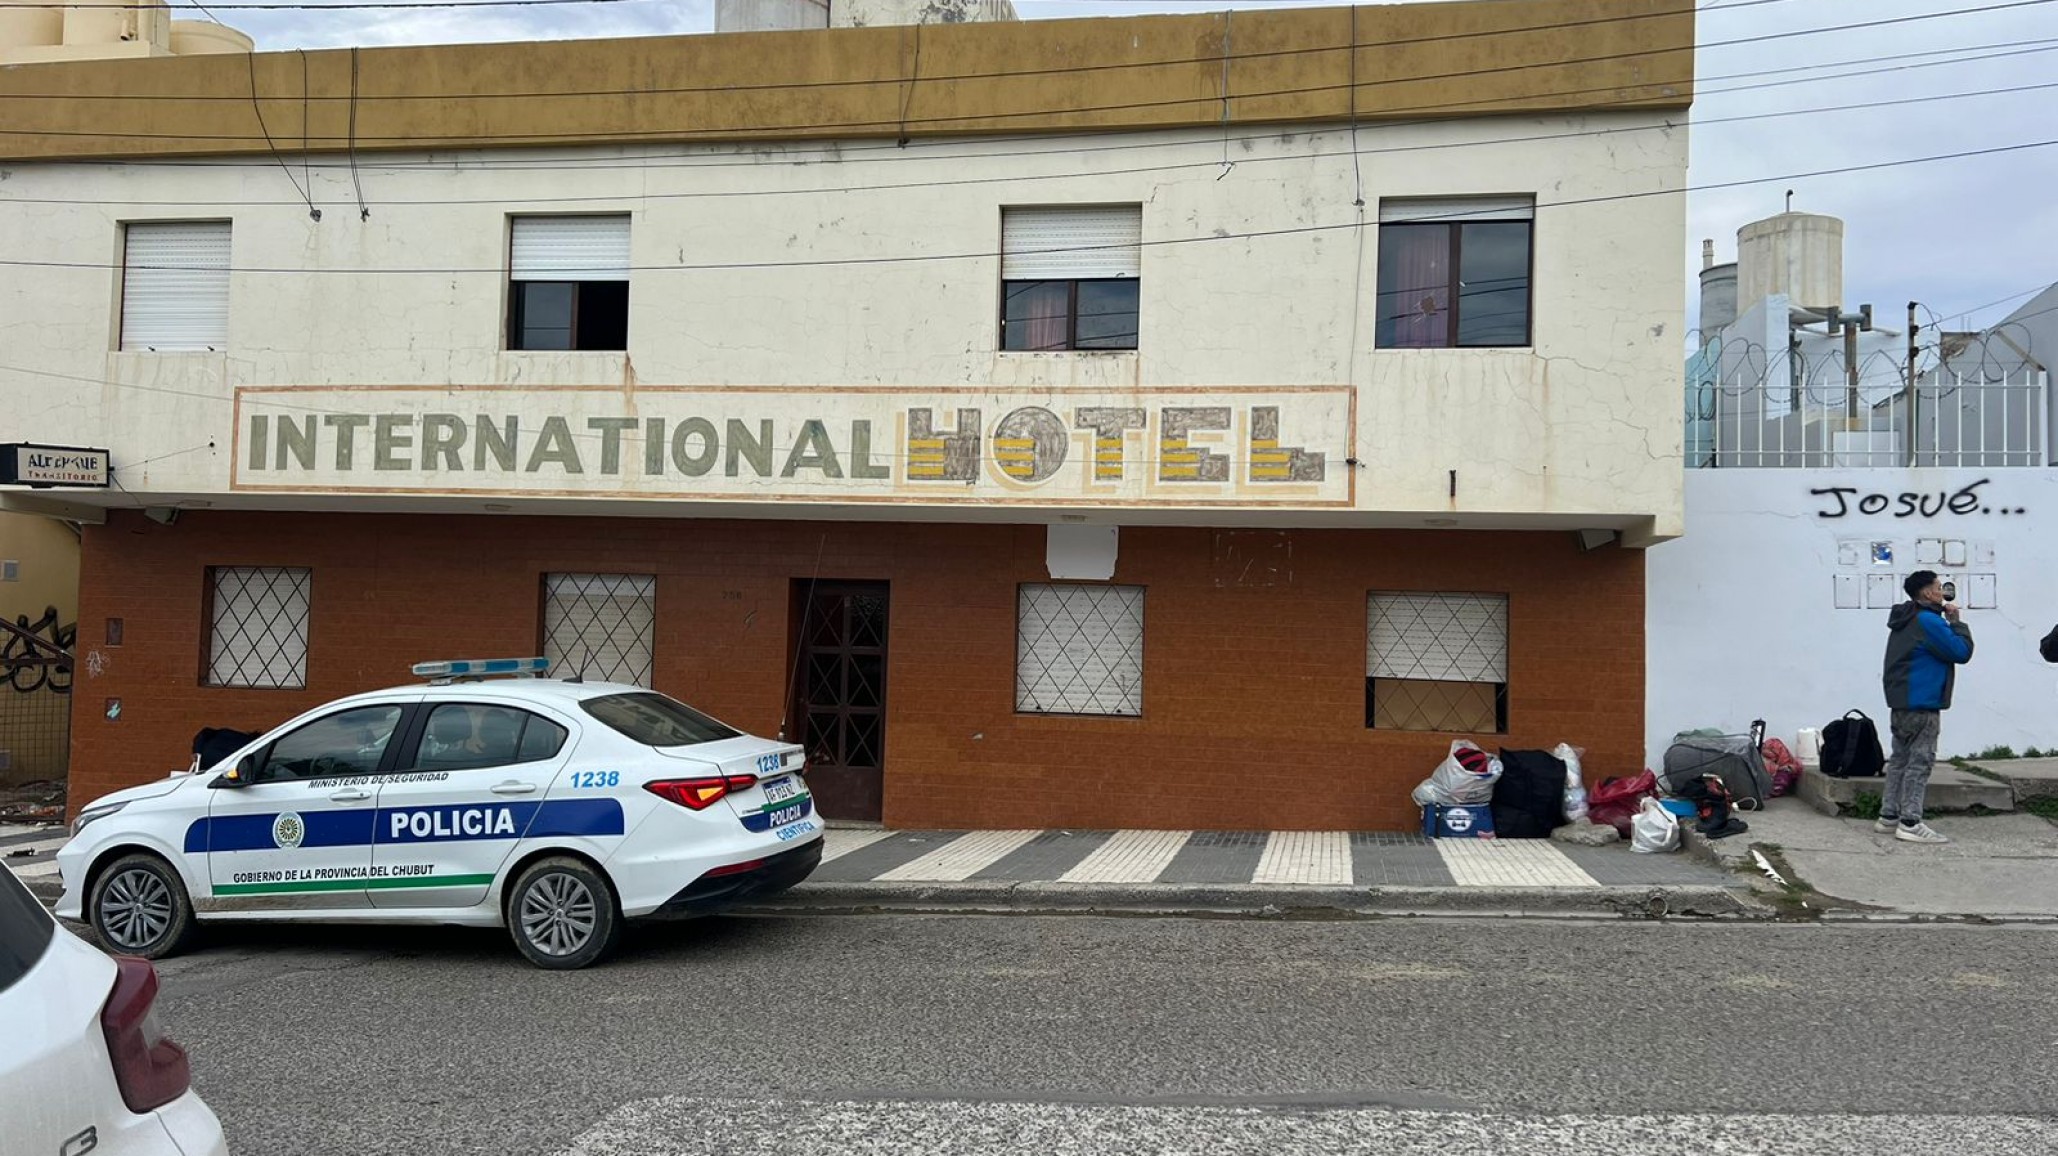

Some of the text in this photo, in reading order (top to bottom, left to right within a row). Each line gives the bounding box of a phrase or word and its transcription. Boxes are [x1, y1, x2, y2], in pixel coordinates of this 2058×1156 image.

[248, 405, 1326, 482] INTERNATIONAL HOTEL
[757, 753, 780, 773] 1238
[308, 776, 369, 789] MINISTERIO
[387, 772, 449, 784] SEGURIDAD
[570, 770, 620, 788] 1238
[391, 807, 516, 839] POLICIA
[769, 804, 801, 828] POLICIA
[233, 864, 435, 883] GOBIERNO DE LA PROVINCIA DEL CHUBUT
